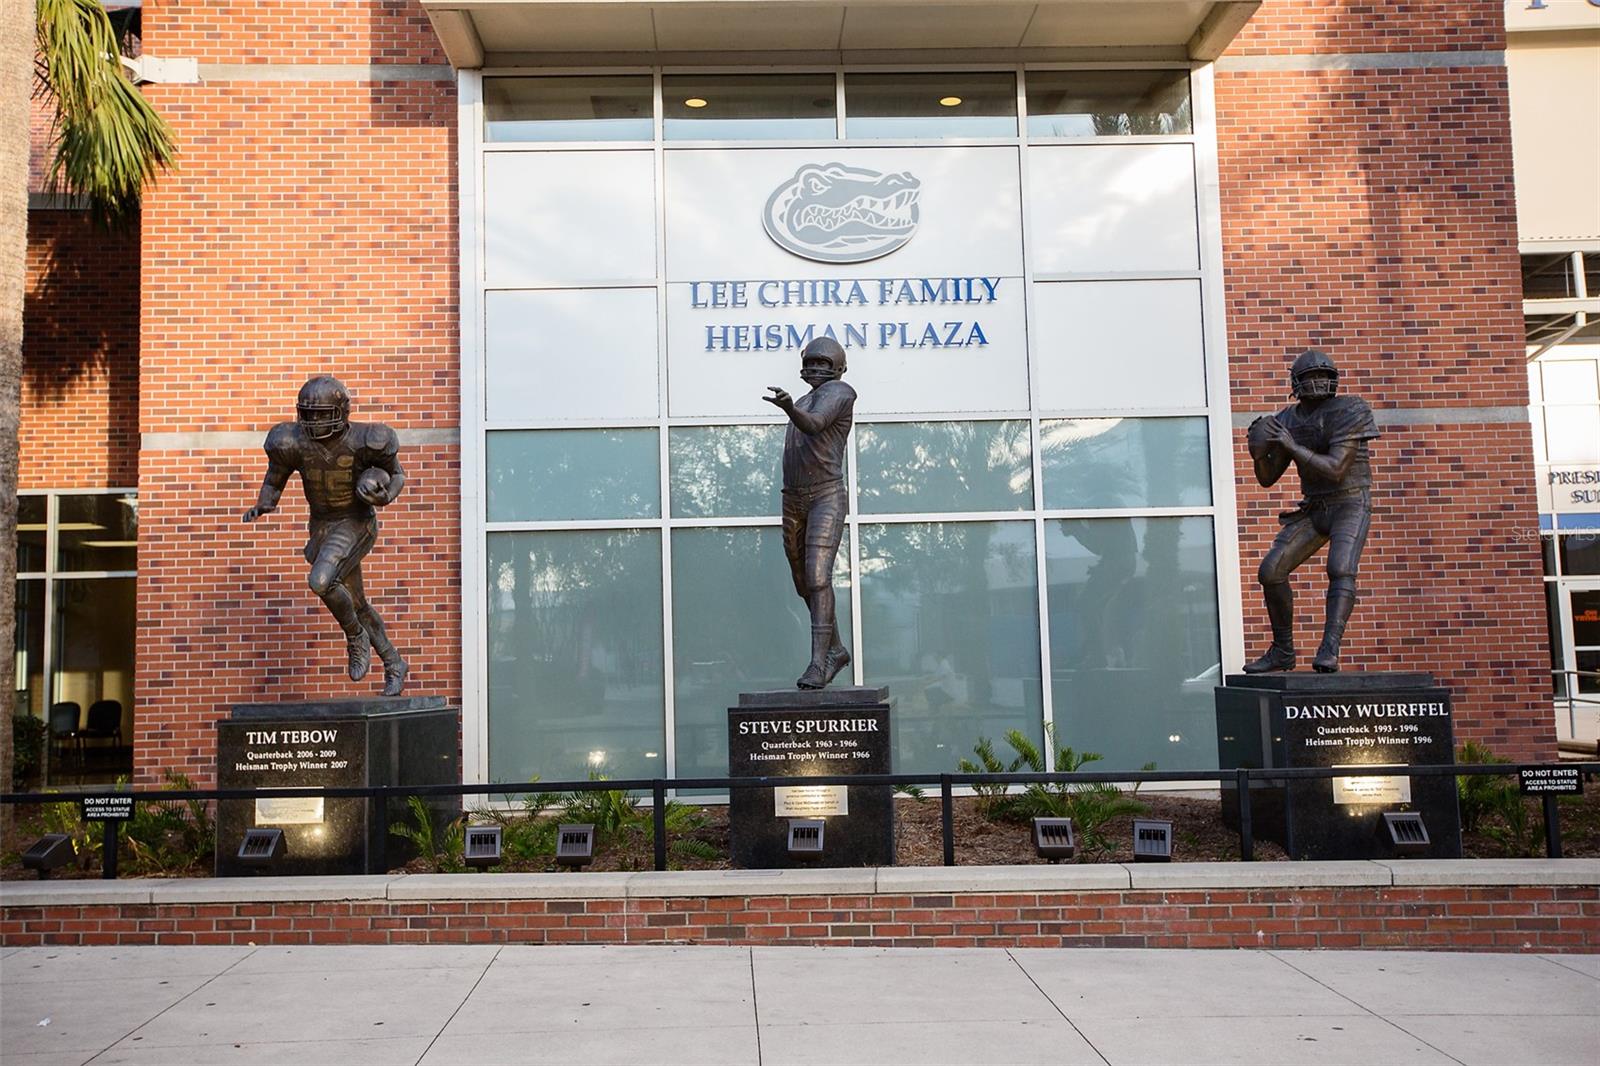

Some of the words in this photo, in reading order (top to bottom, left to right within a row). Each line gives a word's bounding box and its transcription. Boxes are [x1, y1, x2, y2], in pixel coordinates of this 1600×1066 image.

[690, 281, 748, 308] LEE
[758, 279, 869, 307] CHIRA
[879, 277, 1001, 305] FAMILY
[705, 323, 869, 350] HEISMAN
[878, 321, 989, 348] PLAZA
[1285, 704, 1352, 720] DANNY
[1356, 702, 1449, 718] WUERFFEL
[739, 720, 792, 735] STEVE
[795, 718, 879, 733] SPURRIER
[1317, 726, 1370, 735] Quarterback
[1373, 725, 1393, 733] 1993
[1399, 724, 1419, 732] 1996
[246, 731, 277, 745] TIM
[280, 729, 338, 744] TEBOW
[1305, 738, 1343, 747] Heisman
[1345, 737, 1376, 747] Trophy
[1377, 736, 1410, 745] Winner
[1413, 735, 1433, 744] 1996
[761, 741, 811, 750] Quarterback
[815, 740, 833, 748] 1963
[840, 740, 858, 748] 1966
[246, 750, 293, 761] Quarterback
[296, 750, 314, 758] 2006
[319, 750, 337, 758] 2009
[750, 752, 786, 761] Heisman
[787, 752, 817, 762] Trophy
[818, 751, 849, 760] Winner
[852, 751, 871, 759] 1966
[235, 762, 269, 771] Heisman
[270, 762, 298, 772] Trophy
[299, 761, 328, 769] Winner
[330, 760, 348, 769] 2007
[1552, 769, 1579, 777] ENTER
